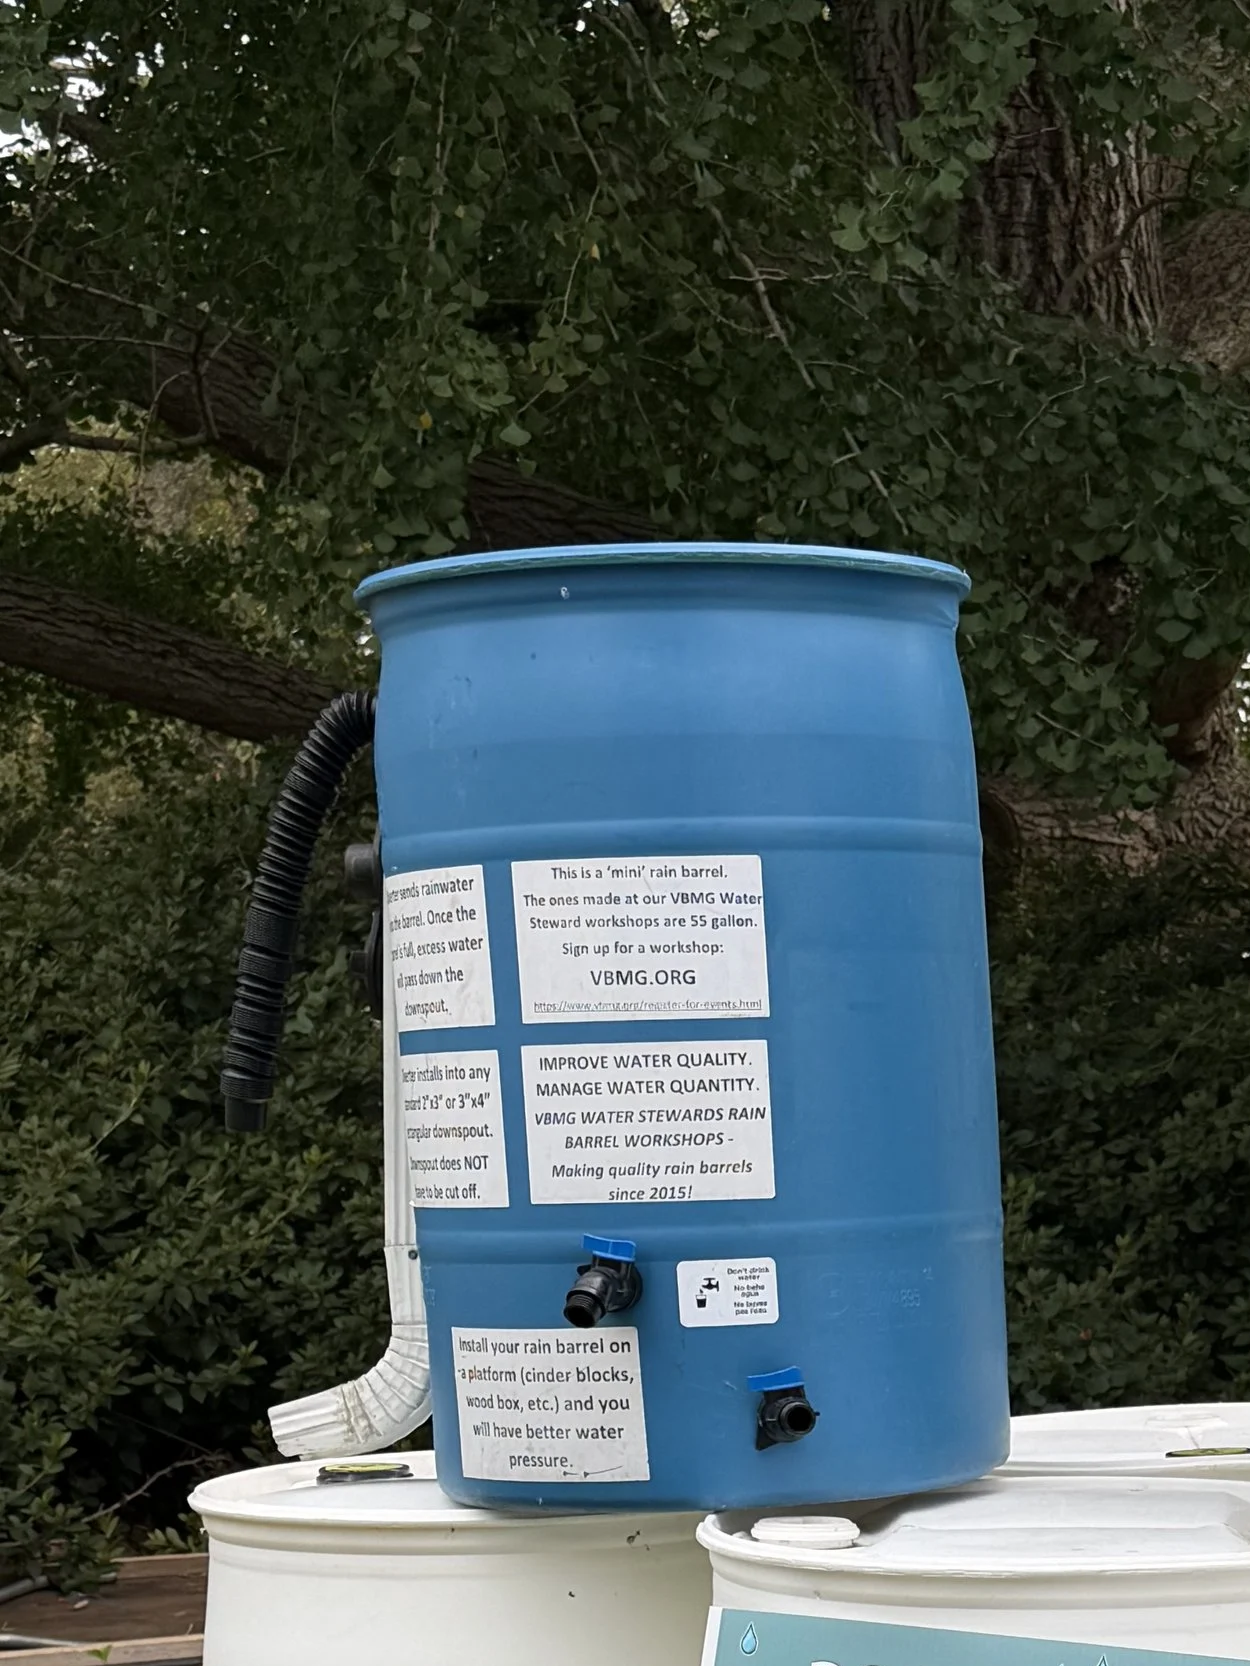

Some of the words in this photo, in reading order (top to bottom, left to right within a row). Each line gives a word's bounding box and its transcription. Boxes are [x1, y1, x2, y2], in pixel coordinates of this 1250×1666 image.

[550, 866, 578, 880] This
[581, 866, 592, 879] is
[595, 869, 603, 879] a
[650, 865, 677, 878] rain
[681, 864, 728, 878] barrel.
[523, 893, 546, 907] The
[549, 895, 579, 906] ones
[583, 892, 621, 905] made
[625, 893, 639, 905] at
[642, 894, 667, 905] our
[670, 892, 716, 905] VBMG
[719, 889, 764, 905] Water
[529, 915, 581, 929] Steward
[585, 914, 660, 930] workshops
[663, 917, 686, 928] are
[690, 914, 707, 927] 55
[711, 914, 758, 930] gallon.
[562, 942, 589, 958] Sign
[593, 944, 610, 957] up
[614, 941, 634, 954] for
[637, 944, 646, 954] a
[649, 940, 724, 956] workshop:
[590, 969, 696, 986] VBMG.ORG
[539, 1055, 609, 1071] IMPROVE
[613, 1054, 672, 1069] WATER
[676, 1052, 752, 1069] QUALITY.
[536, 1082, 603, 1097] MANAGE
[606, 1080, 665, 1095] WATER
[670, 1077, 760, 1095] QUANTITY.
[535, 1111, 576, 1126] VBMG
[581, 1110, 634, 1125] WATER
[638, 1107, 724, 1123] STEWARDS
[728, 1106, 766, 1121] RAIN
[565, 1135, 619, 1149] BARREL
[624, 1132, 724, 1148] WORKSHOPS
[552, 1163, 604, 1180] Making
[608, 1162, 661, 1180] quality
[664, 1161, 695, 1175] rain
[699, 1159, 753, 1174] barrels
[459, 1337, 488, 1353] Install
[490, 1342, 520, 1356] your
[524, 1338, 551, 1354] rain
[556, 1337, 604, 1354] barrel
[609, 1340, 631, 1354] on
